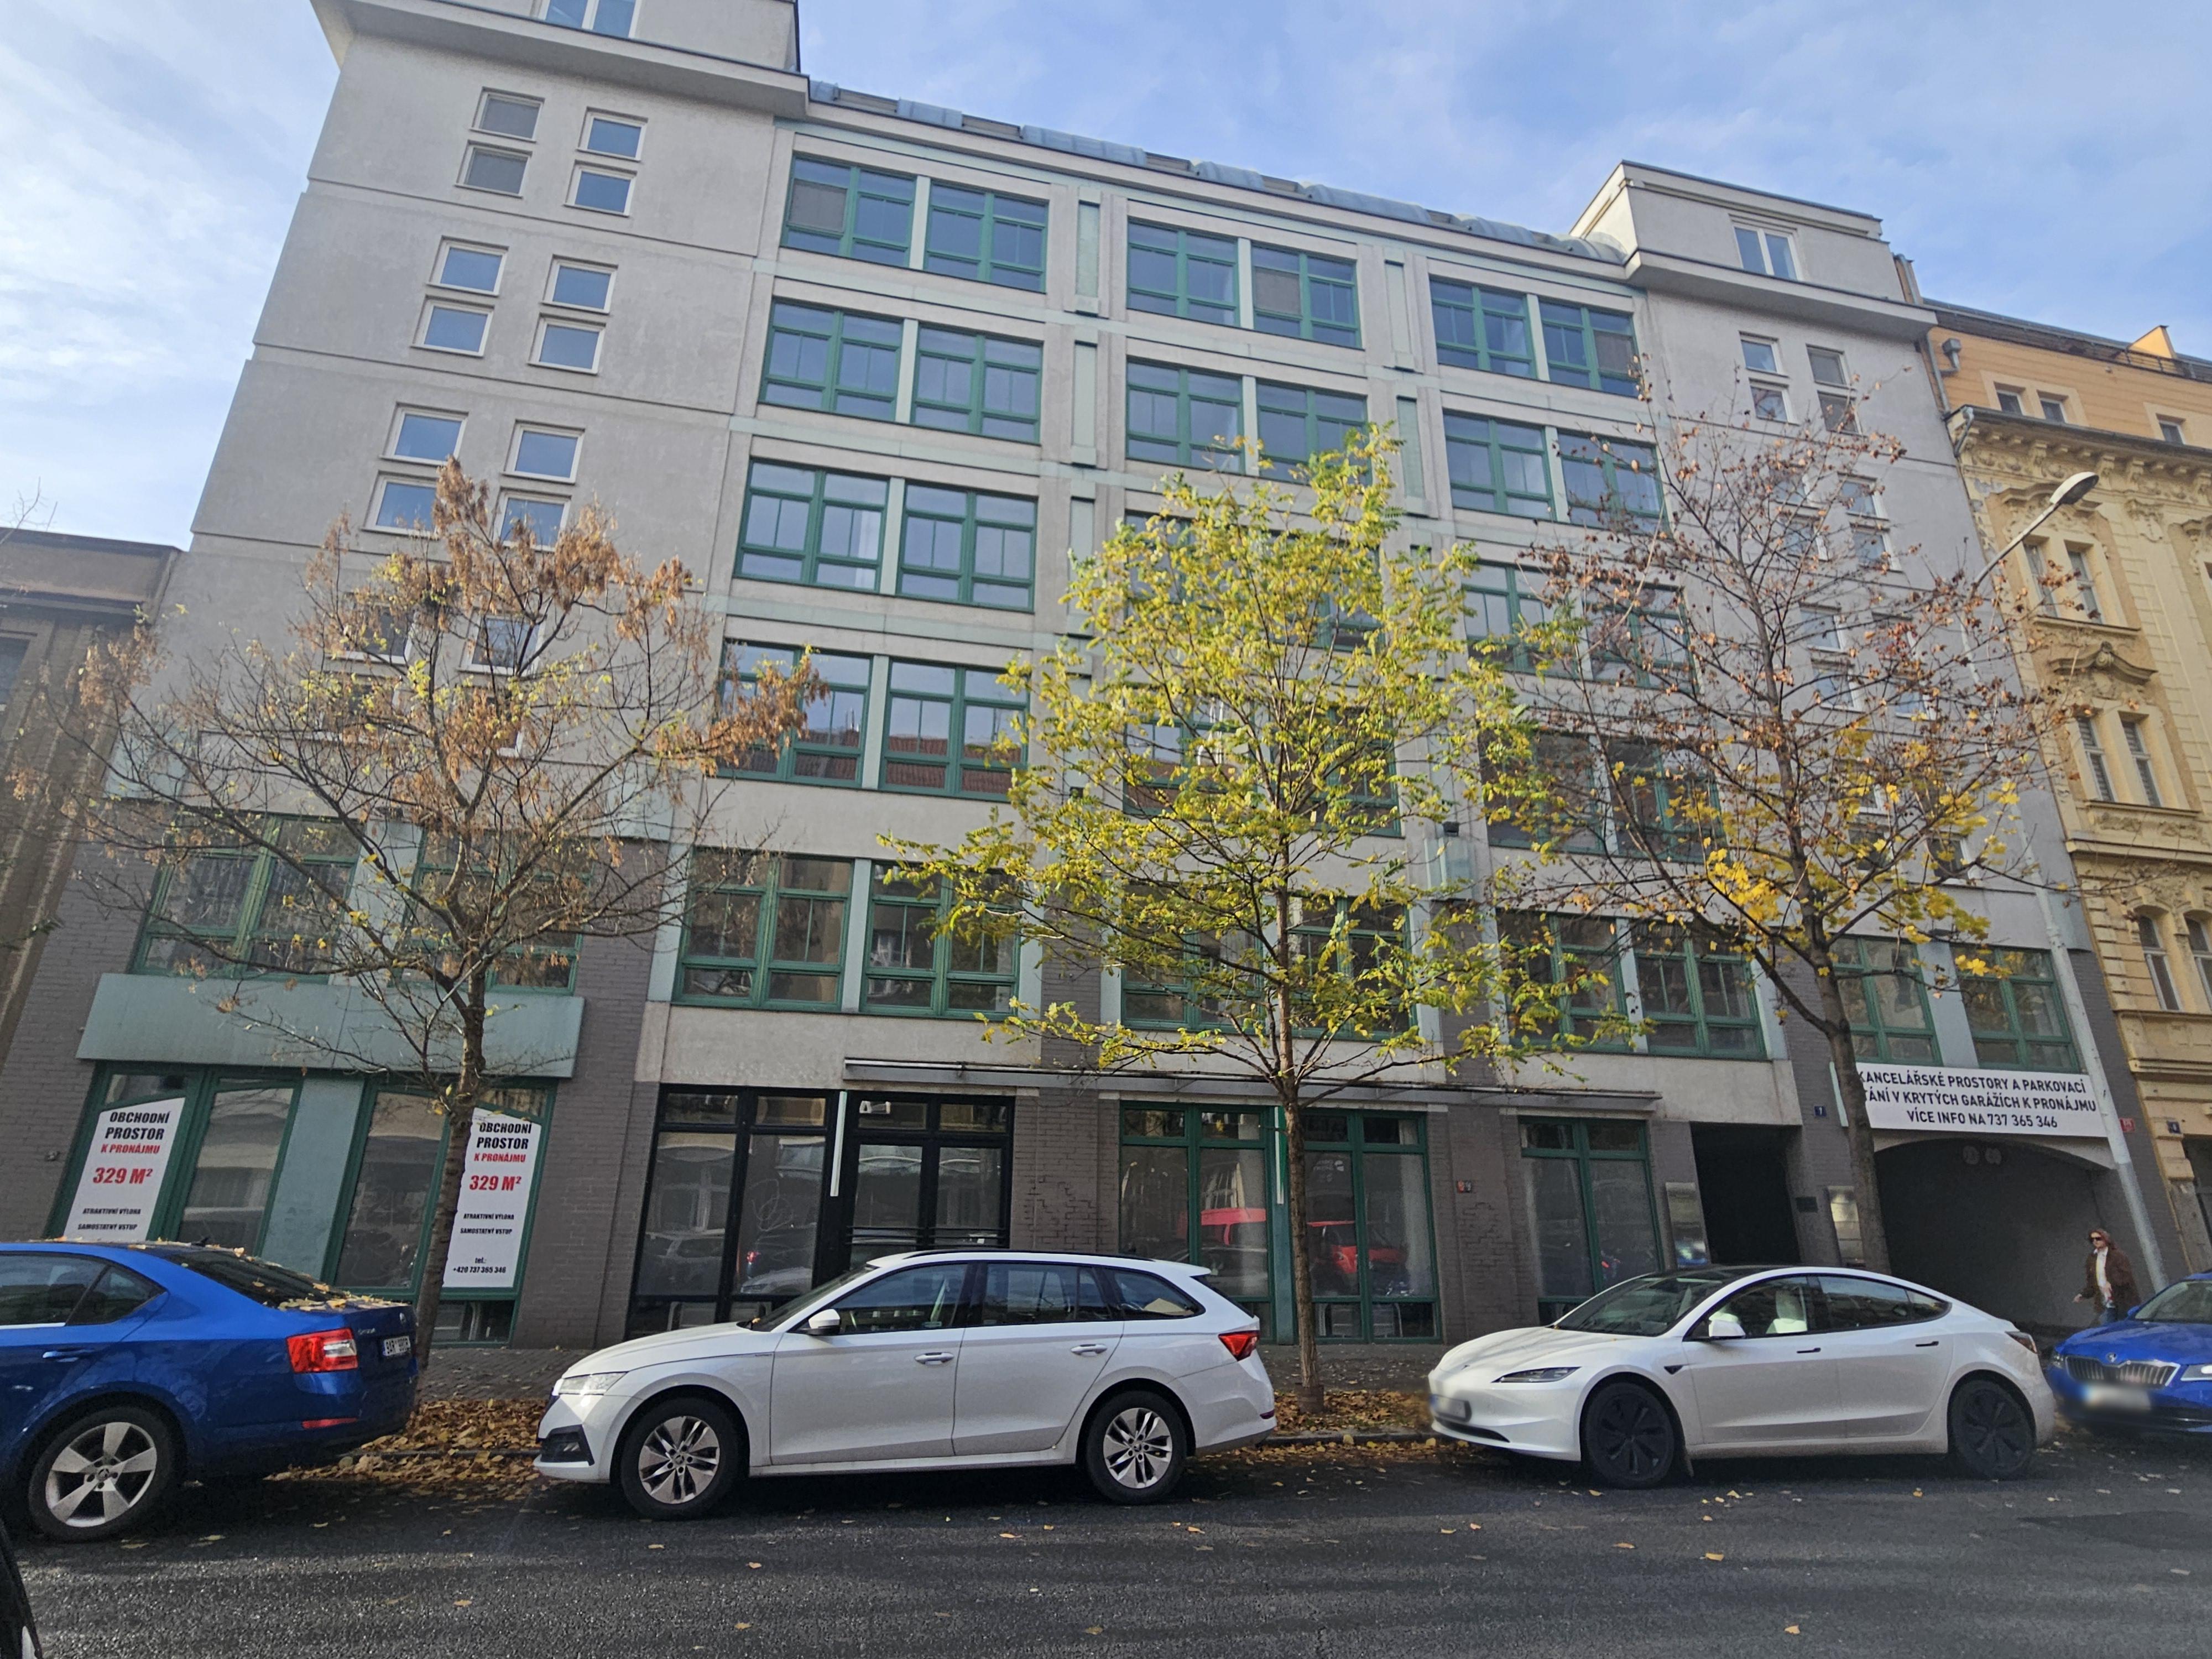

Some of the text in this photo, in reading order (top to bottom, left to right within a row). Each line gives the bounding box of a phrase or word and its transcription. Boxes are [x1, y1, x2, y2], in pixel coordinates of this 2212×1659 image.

[1859, 1070, 2086, 1093] KANCELÁŘSKÉ PROSTORY A PARKOVACÍ
[1864, 1086, 2096, 1112] ÁNÍ V KRYTÝCH GARÁŽÍCH K PRONÁJMU
[109, 1111, 171, 1123] OBCHODNÍ
[1907, 1107, 2058, 1128] VÍCE INFO NA 737 365 346
[105, 1127, 164, 1140] PROSTOR
[479, 1121, 532, 1134] OBCHODNÍ
[101, 1143, 160, 1154] K PRONÁJMU
[476, 1136, 529, 1149] PROSTOR
[474, 1152, 526, 1162] K PRONÁJMU
[93, 1167, 127, 1184] 329
[469, 1175, 499, 1191] 329
